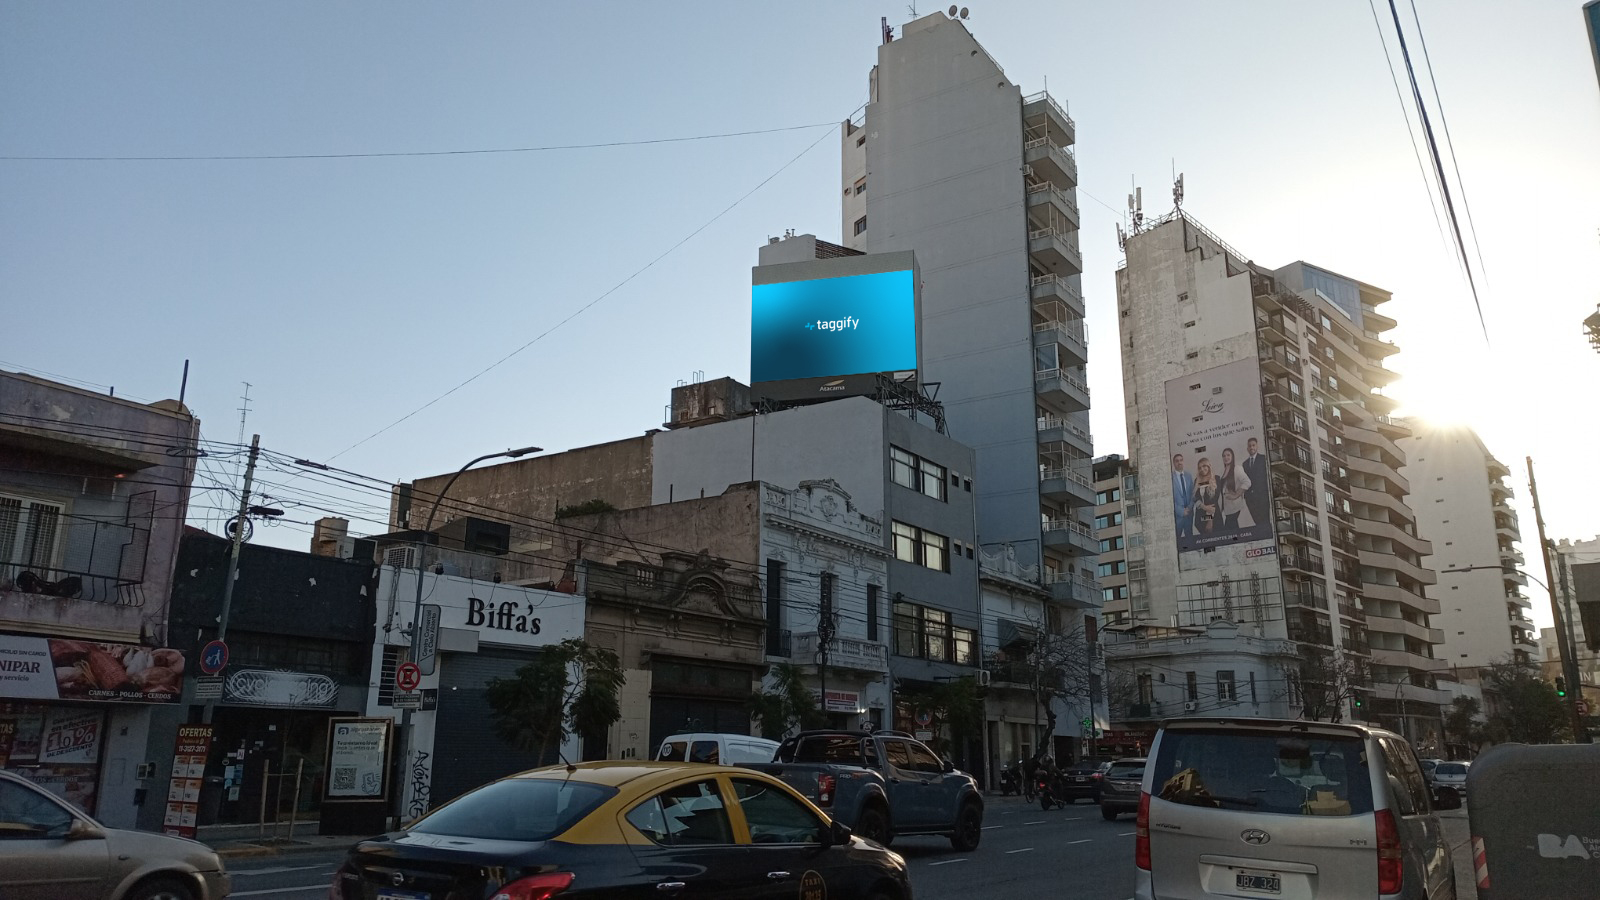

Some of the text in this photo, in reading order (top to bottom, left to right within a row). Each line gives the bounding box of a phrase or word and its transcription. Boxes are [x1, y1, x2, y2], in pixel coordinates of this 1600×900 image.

[817, 316, 859, 331] taggify
[820, 384, 845, 392] Atacama
[1247, 547, 1276, 557] GLOBAL
[466, 597, 541, 635] Biffa's
[88, 689, 114, 697] CARNES
[119, 690, 143, 698] POLLOS
[147, 692, 172, 700] CERDOS
[179, 728, 213, 737] OFERTAS
[804, 878, 821, 886] TAXI
[1237, 875, 1278, 889] JBZ 324
